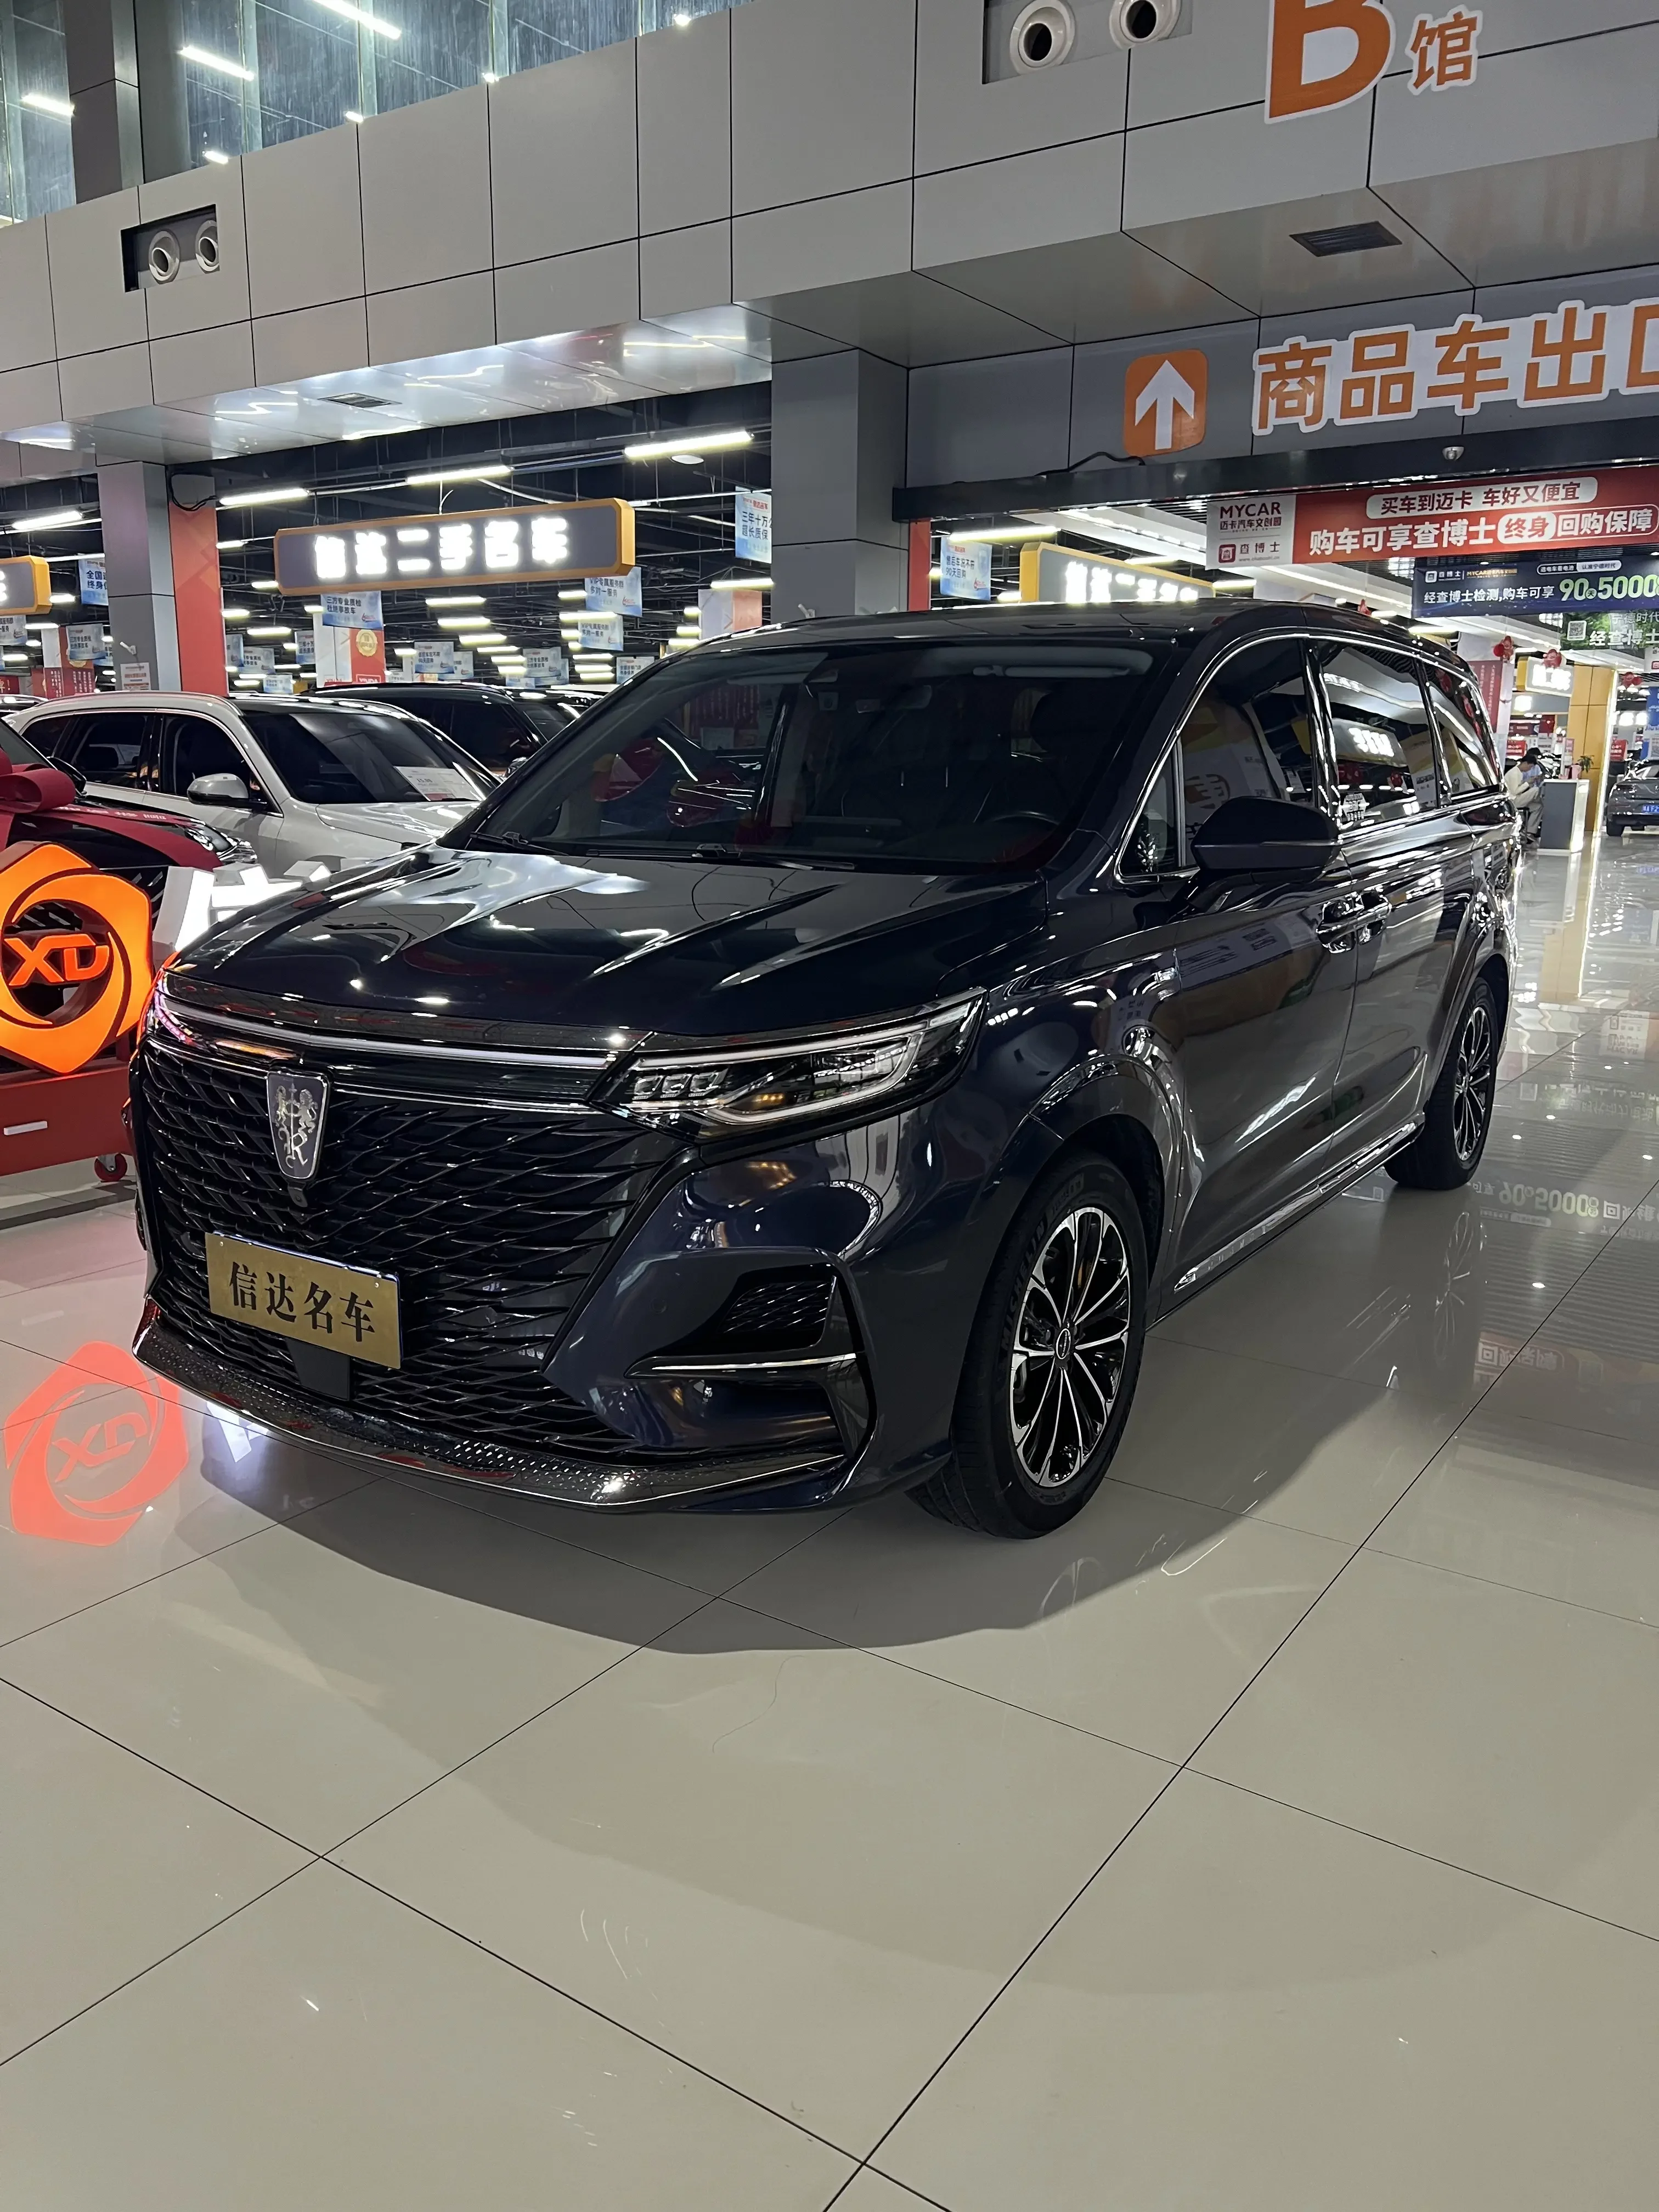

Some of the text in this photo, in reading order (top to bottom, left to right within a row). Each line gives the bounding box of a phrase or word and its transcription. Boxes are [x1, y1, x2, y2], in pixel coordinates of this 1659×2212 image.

[1381, 482, 1581, 515] 买车到迈卡 车好又便宜
[1220, 501, 1282, 519] MYCAR
[1240, 541, 1280, 555] 查博士
[86, 570, 106, 580] 全国
[87, 579, 107, 590] 终身
[1424, 585, 1555, 603] 经查博士检测,购车可享
[1589, 628, 1659, 646] 经查博士
[2, 933, 110, 987] XD
[1000, 1218, 1045, 1350] MICHELIN
[229, 1261, 375, 1343] 信达名车
